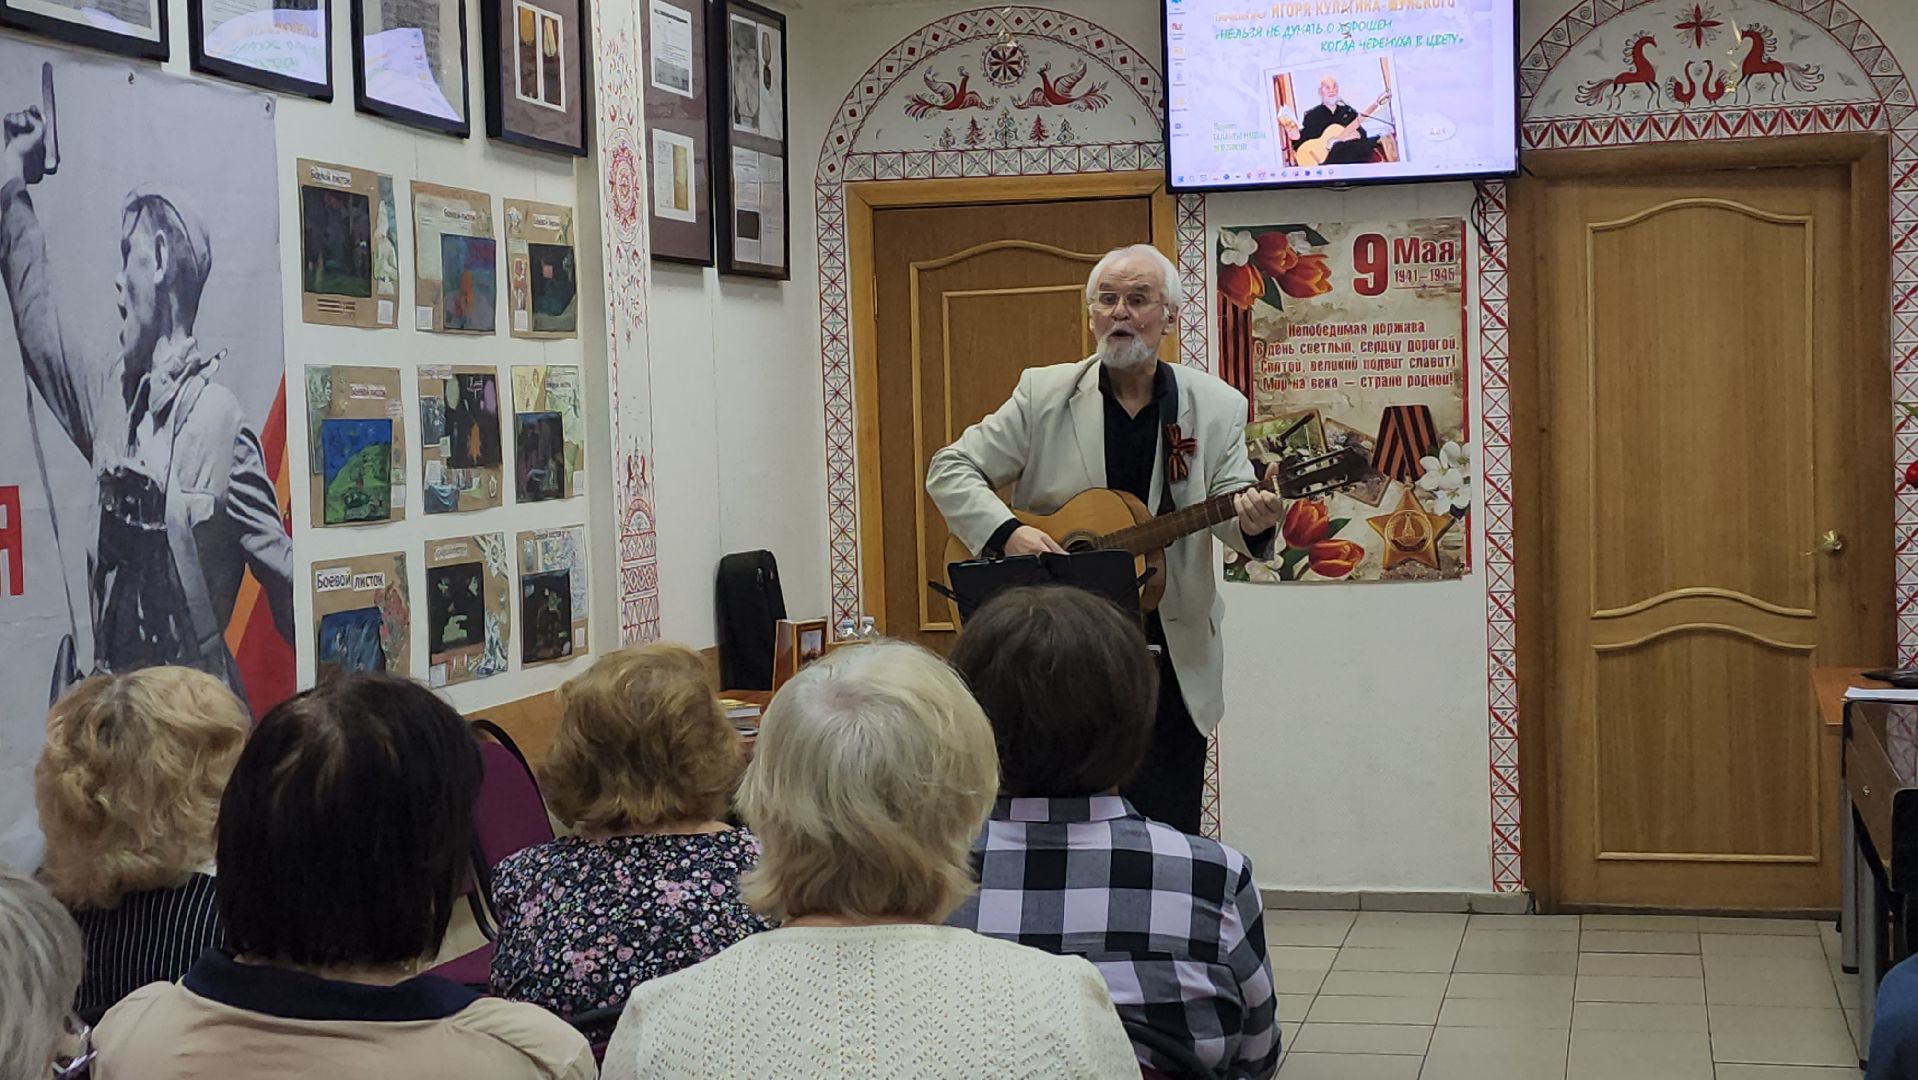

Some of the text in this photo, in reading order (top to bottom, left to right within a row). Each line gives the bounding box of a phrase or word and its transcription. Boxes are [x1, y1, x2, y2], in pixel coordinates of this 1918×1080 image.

[1271, 2, 1311, 18] ИГОРЯ
[1266, 25, 1280, 37] НЕ
[1282, 23, 1323, 39] ДУМАТЬ
[1326, 23, 1334, 33] О
[1320, 39, 1356, 54] КОГДА
[1416, 35, 1423, 47] В
[1352, 233, 1455, 297] 9 Мая
[1288, 321, 1425, 337] Непобедимая держава
[1267, 343, 1296, 357] день
[1360, 340, 1402, 354] сердцу
[1310, 355, 1358, 372] великий
[1363, 357, 1403, 372] подвиг
[1409, 353, 1456, 369] славит!
[1263, 377, 1288, 392] Мир
[1292, 378, 1306, 389] на
[1311, 376, 1339, 390] века
[1360, 375, 1402, 390] стране
[1407, 371, 1454, 388] родной!
[317, 569, 384, 589] Боевой листок
